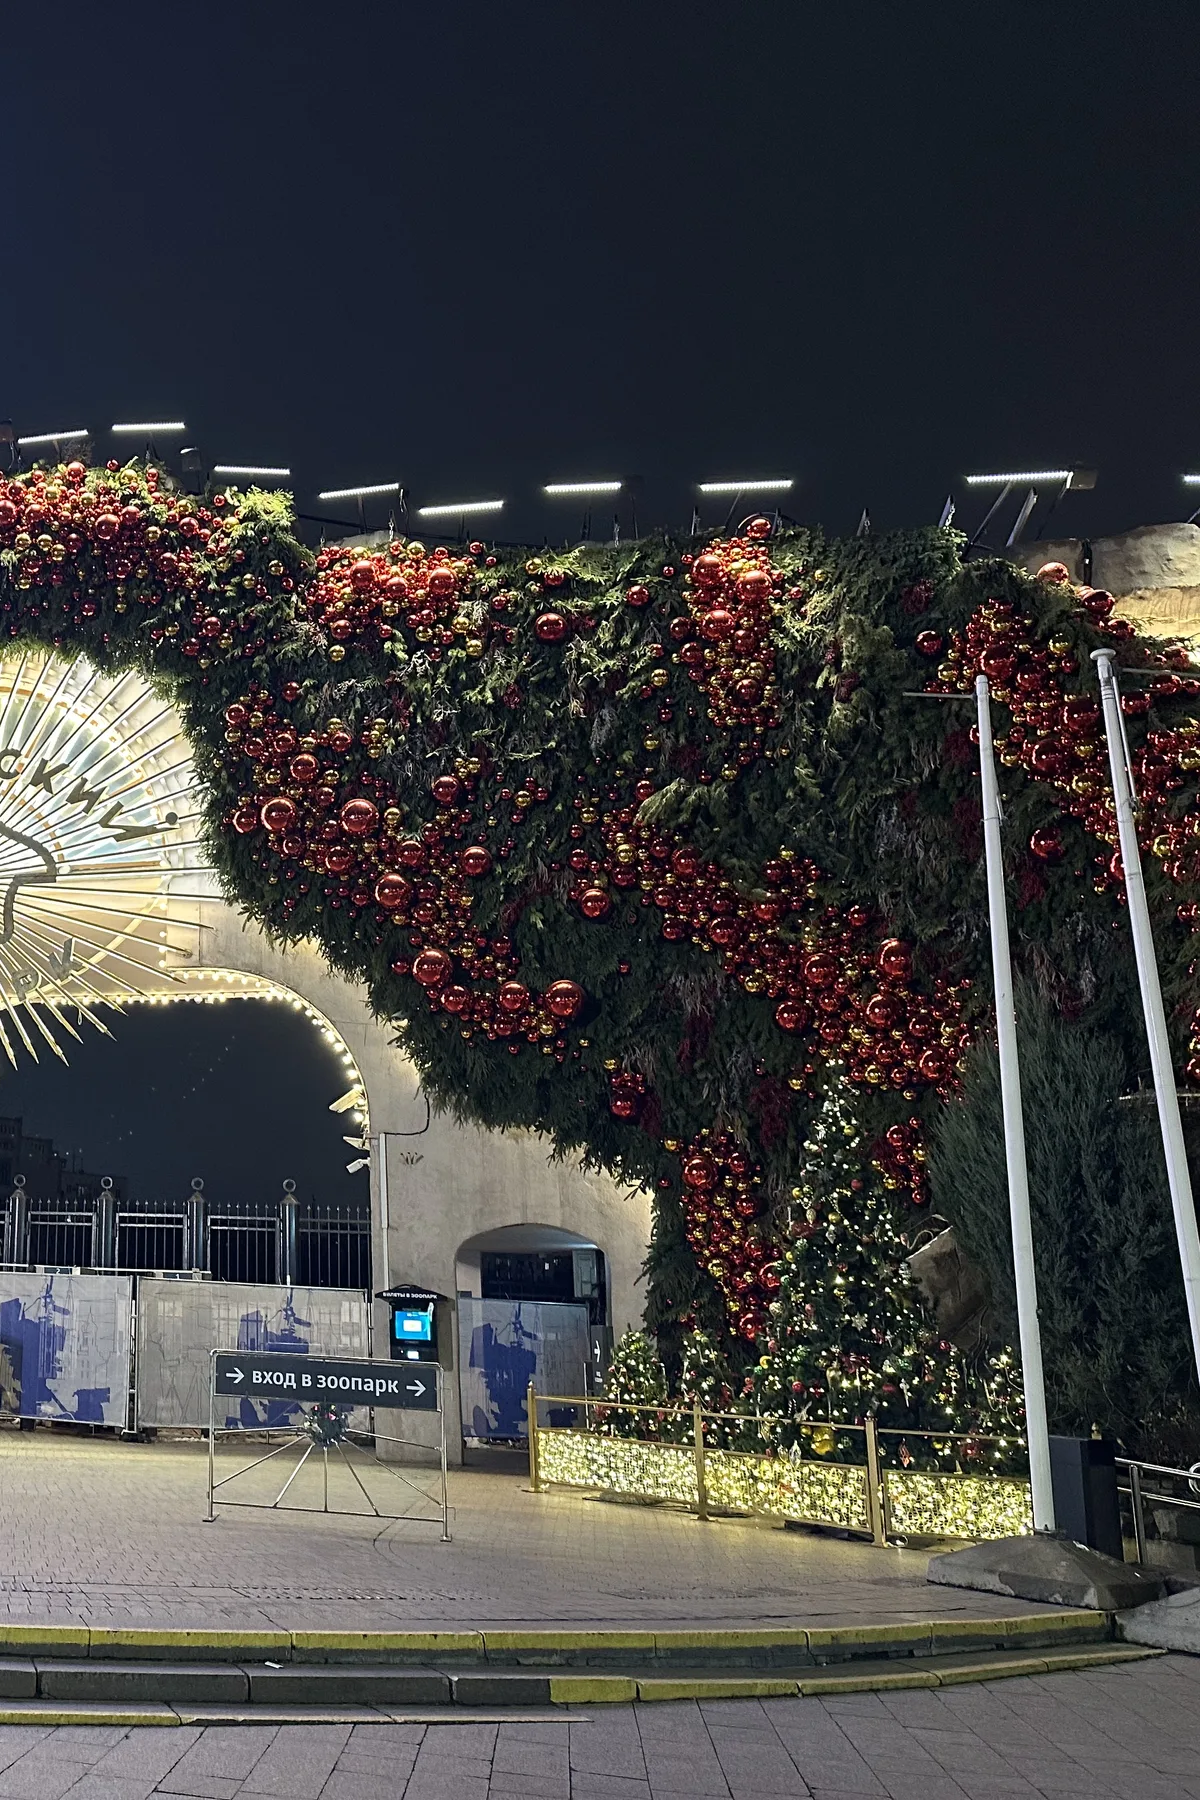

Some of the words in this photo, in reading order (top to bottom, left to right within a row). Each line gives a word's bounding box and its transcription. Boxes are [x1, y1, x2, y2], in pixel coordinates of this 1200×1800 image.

[252, 1370, 297, 1390] вход
[301, 1373, 312, 1388] в
[316, 1374, 399, 1397] зоопарк
